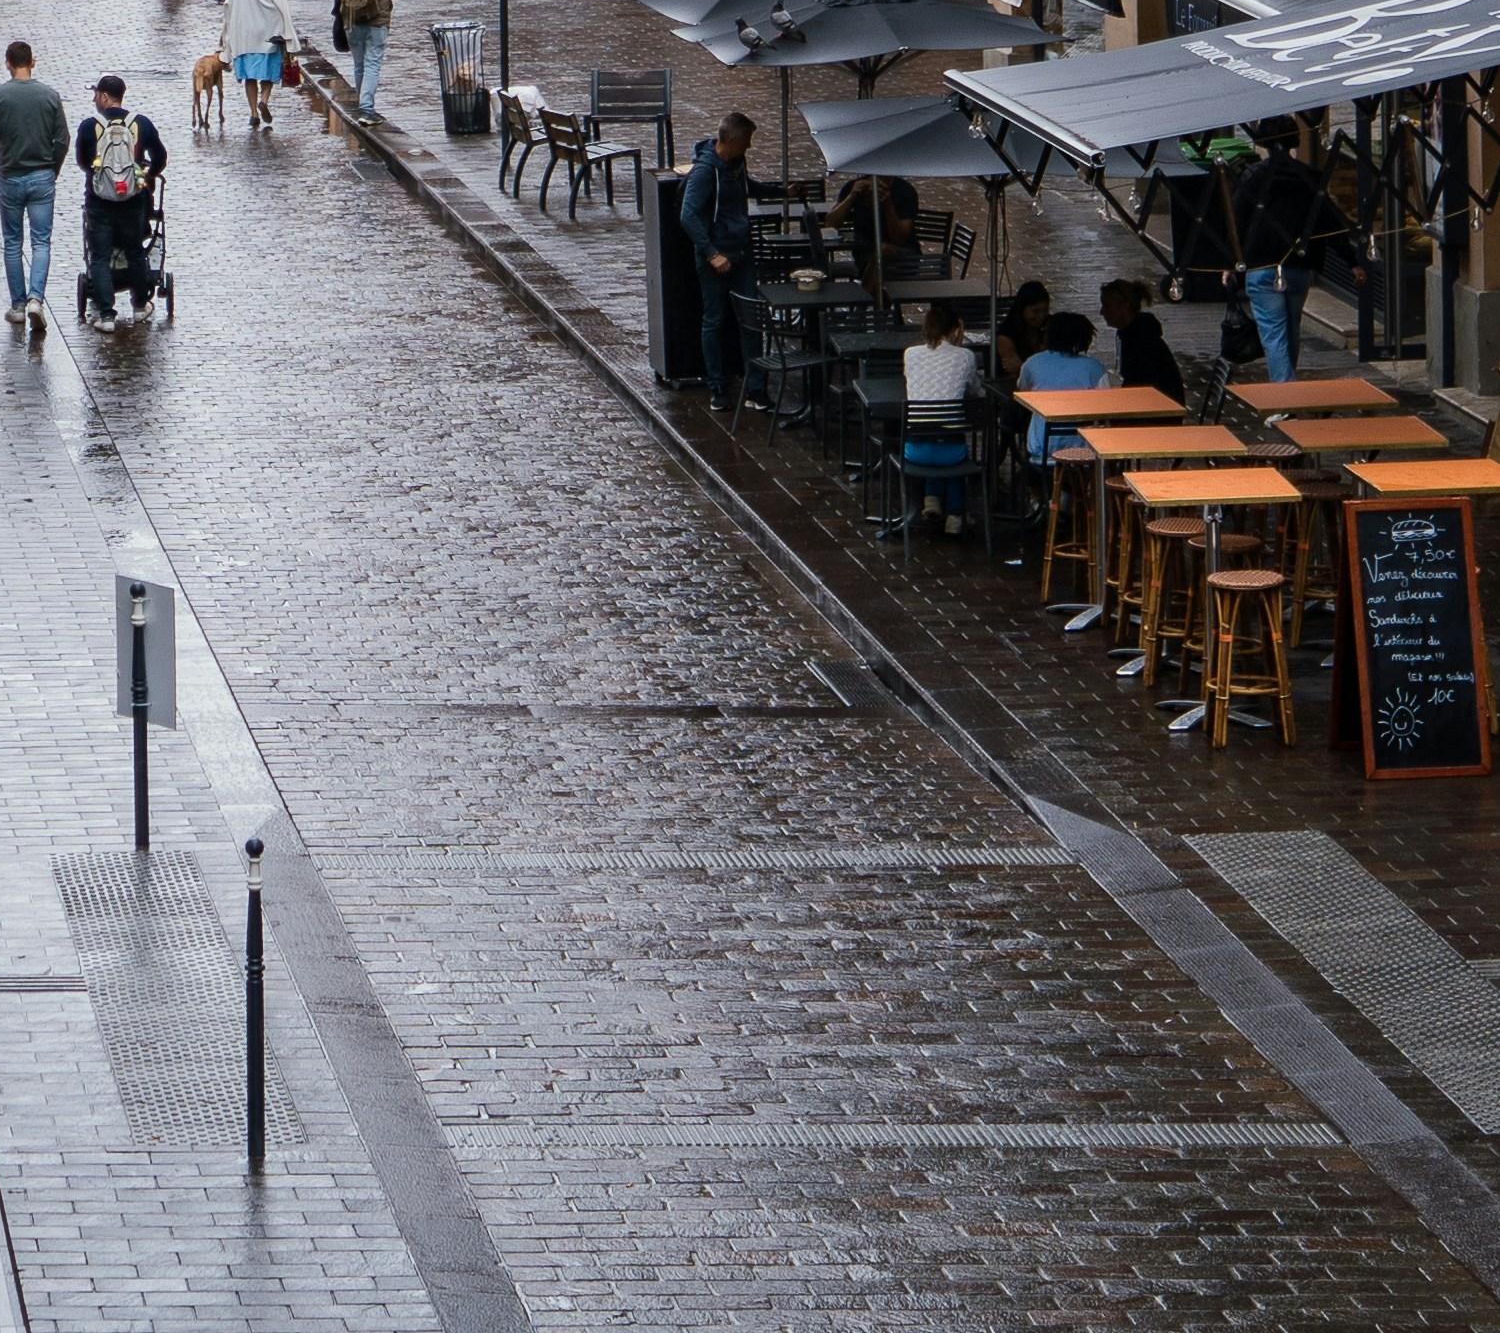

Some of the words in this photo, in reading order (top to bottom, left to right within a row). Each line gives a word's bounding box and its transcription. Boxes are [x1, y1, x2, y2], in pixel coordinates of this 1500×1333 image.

[1405, 548, 1457, 564] 7,50€
[1362, 552, 1410, 587] Venez
[1366, 595, 1387, 605] nos
[1429, 614, 1437, 623] à
[1427, 635, 1441, 646] du
[1428, 673, 1443, 682] nos
[1427, 688, 1456, 704] 10€
